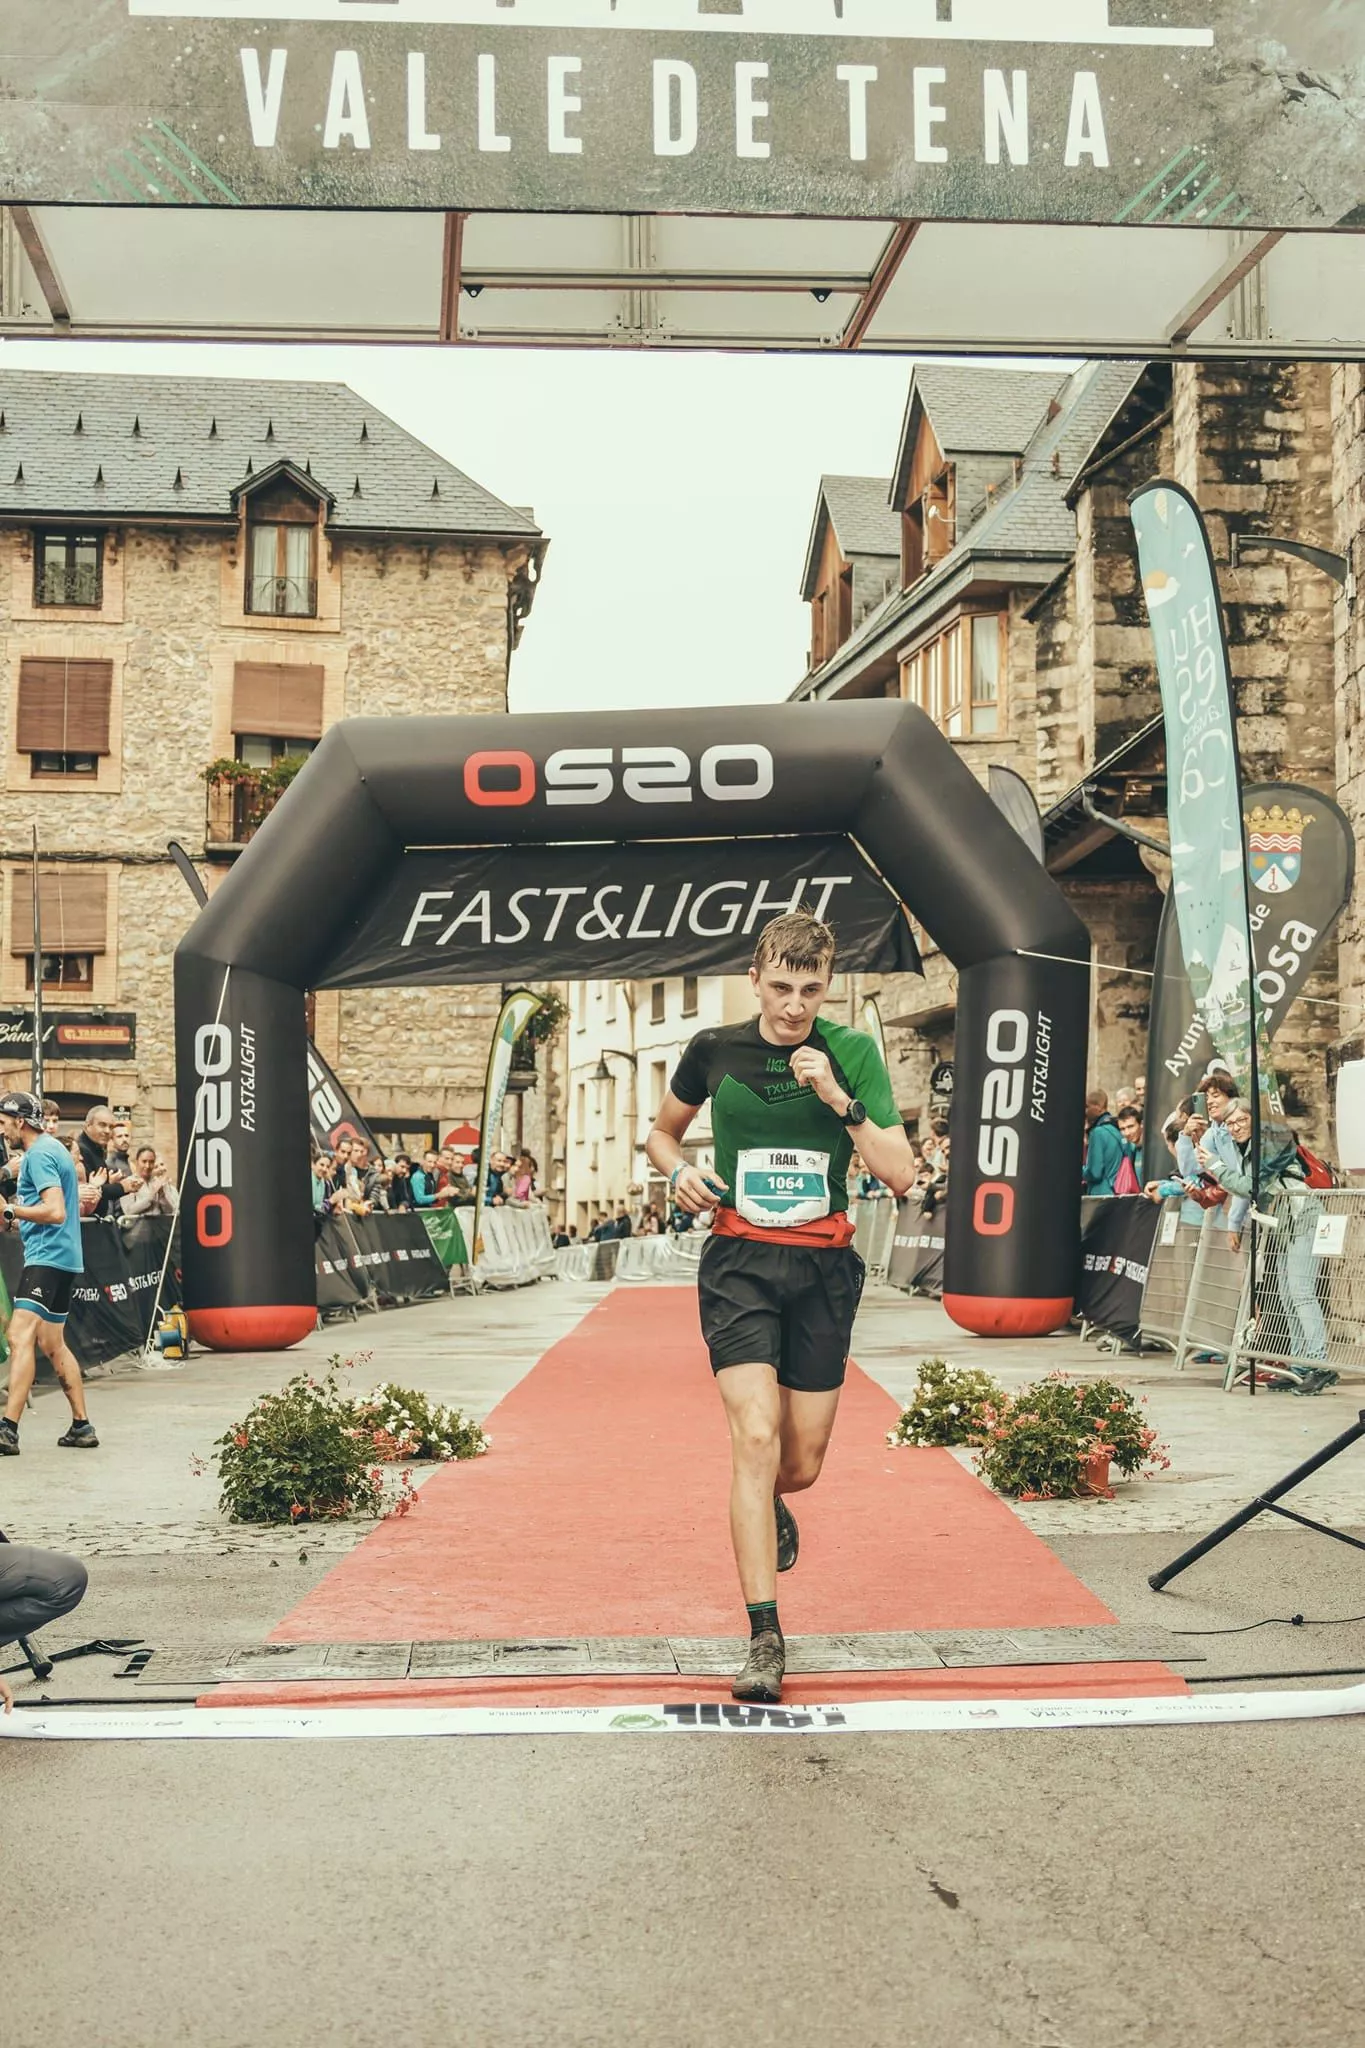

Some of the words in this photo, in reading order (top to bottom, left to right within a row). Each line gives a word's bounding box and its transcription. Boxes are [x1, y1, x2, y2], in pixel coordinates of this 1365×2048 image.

[240, 47, 583, 154] VALLE
[652, 59, 771, 159] DE
[836, 62, 1111, 168] TENA
[400, 876, 853, 946] FAST&LIGHT
[1250, 903, 1271, 931] de
[0, 1023, 54, 1044] Bancl
[240, 1022, 256, 1132] FAST&LIGHT
[1030, 1010, 1054, 1123] FAST&LIGHT
[767, 1176, 804, 1190] 1064
[769, 1152, 800, 1166] TRAIL
